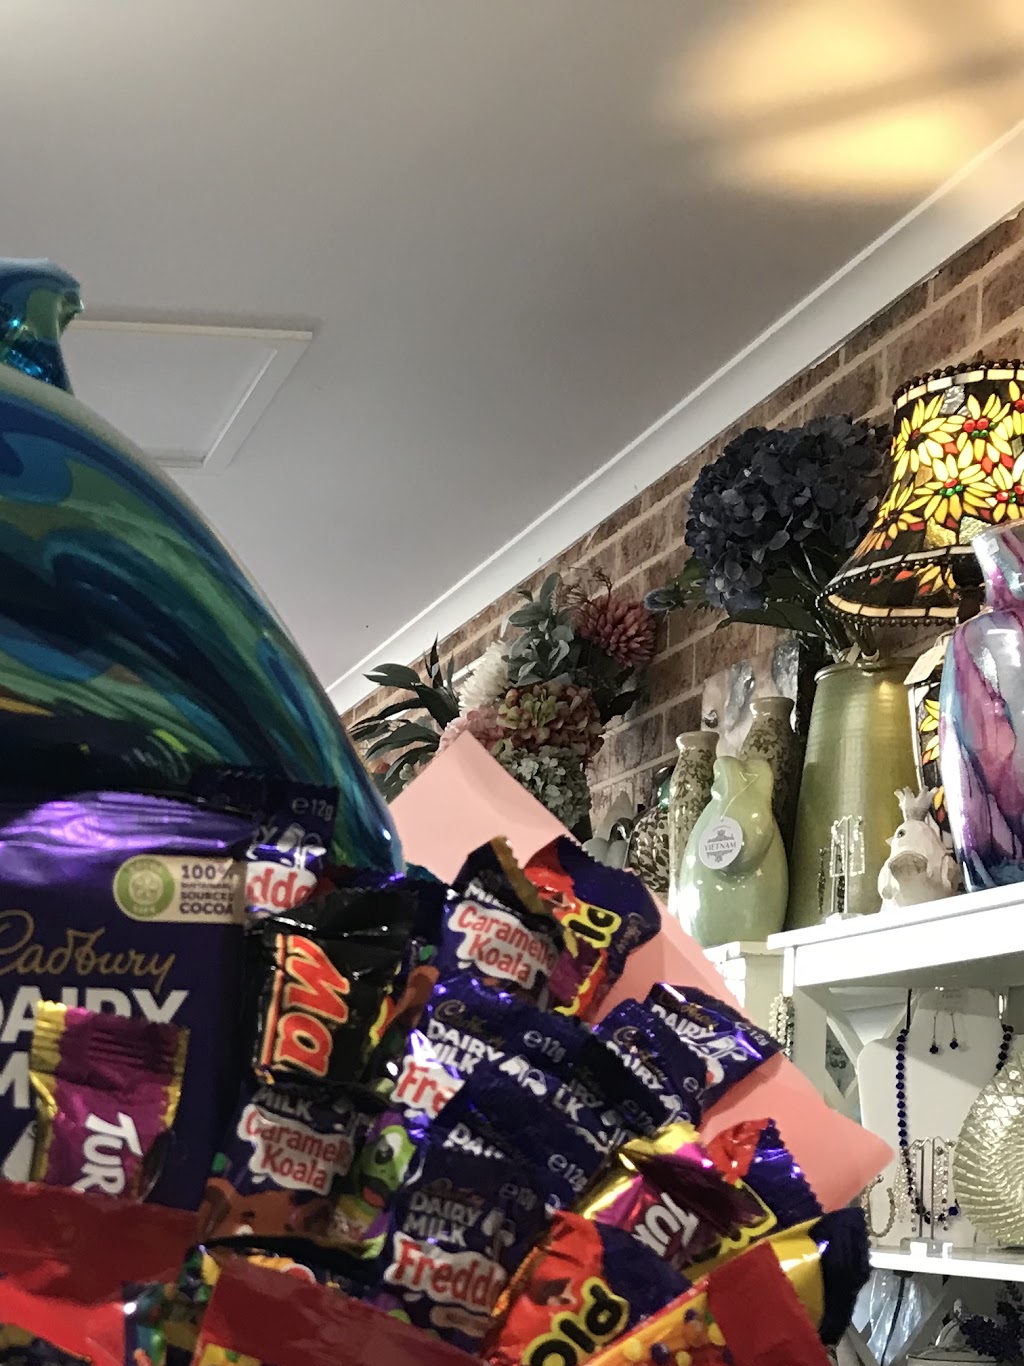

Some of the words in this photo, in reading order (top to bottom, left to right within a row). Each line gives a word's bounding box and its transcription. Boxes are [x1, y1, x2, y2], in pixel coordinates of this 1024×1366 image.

[704, 841, 736, 851] VIETNAM
[469, 934, 532, 982] Koala
[272, 934, 350, 1077] Ma
[428, 1018, 505, 1062] DAIRY
[261, 1144, 327, 1190] Koala
[403, 1212, 467, 1247] MILK
[410, 1190, 484, 1227] DAIRY
